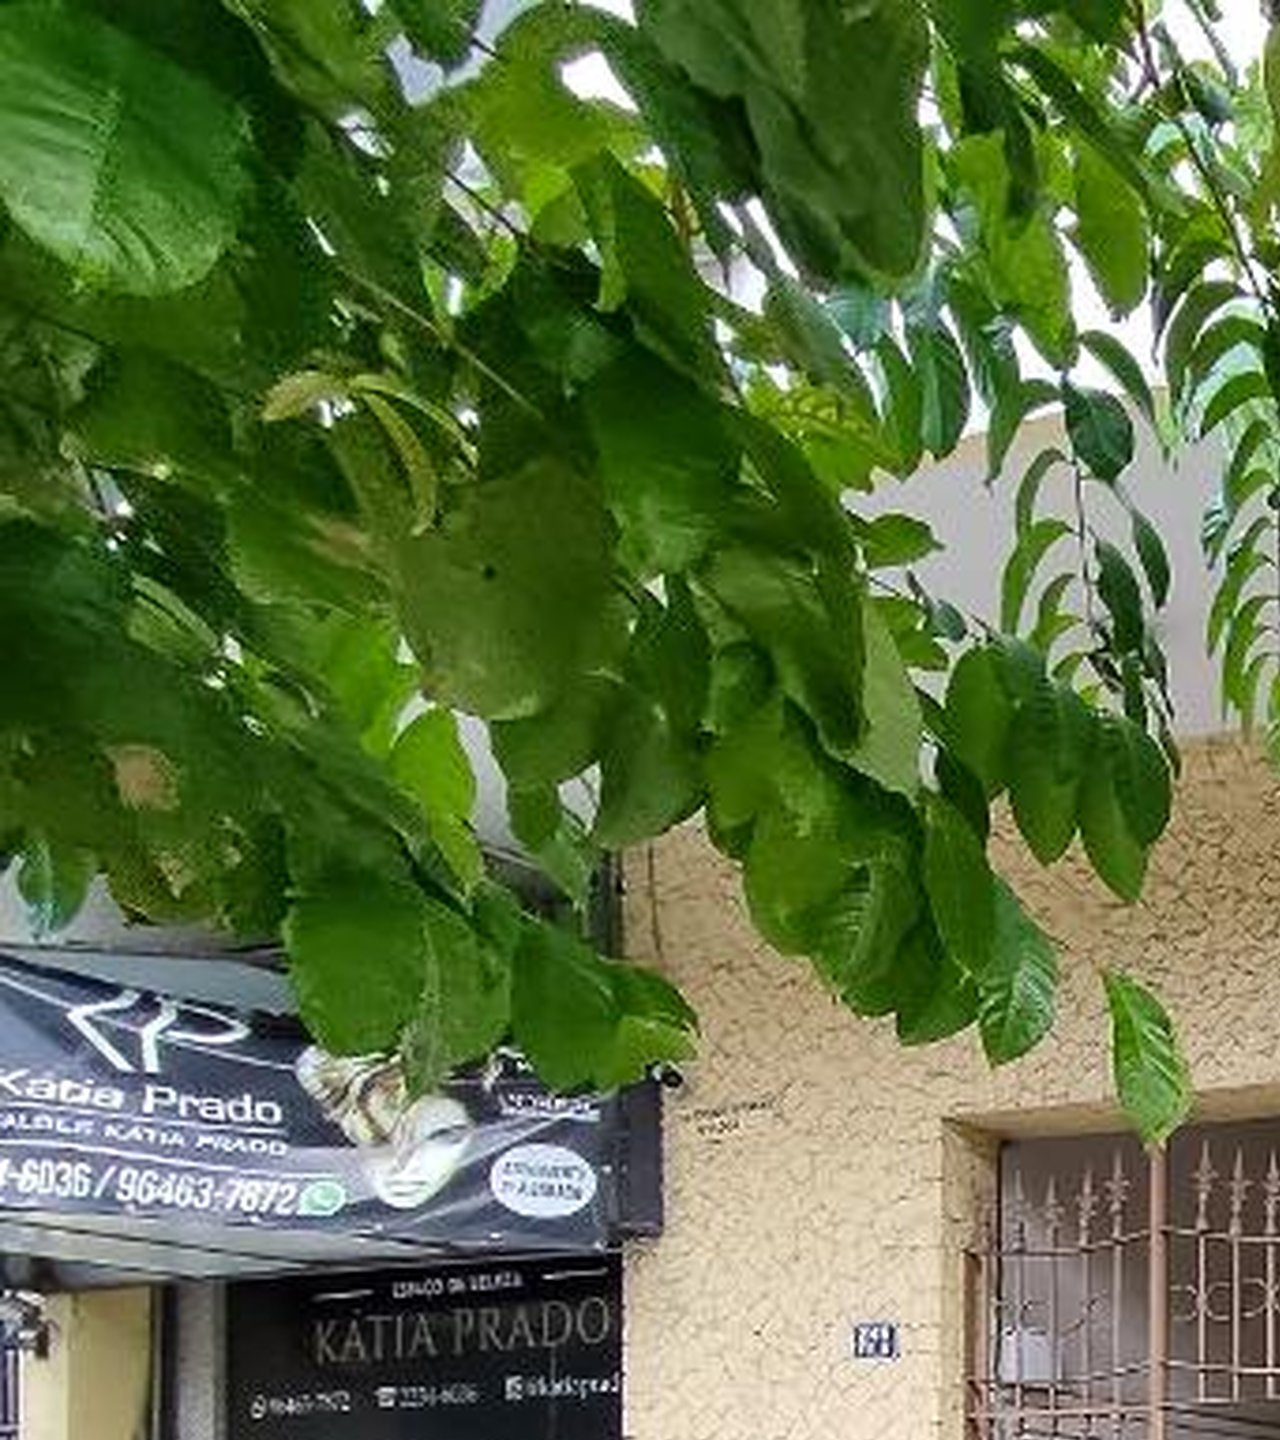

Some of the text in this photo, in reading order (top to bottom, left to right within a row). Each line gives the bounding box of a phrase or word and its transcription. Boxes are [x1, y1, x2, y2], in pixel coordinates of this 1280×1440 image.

[142, 1084, 283, 1124] Prado
[116, 1167, 298, 1216] 96463-7872
[315, 1297, 612, 1364] KÁTIA PRADO
